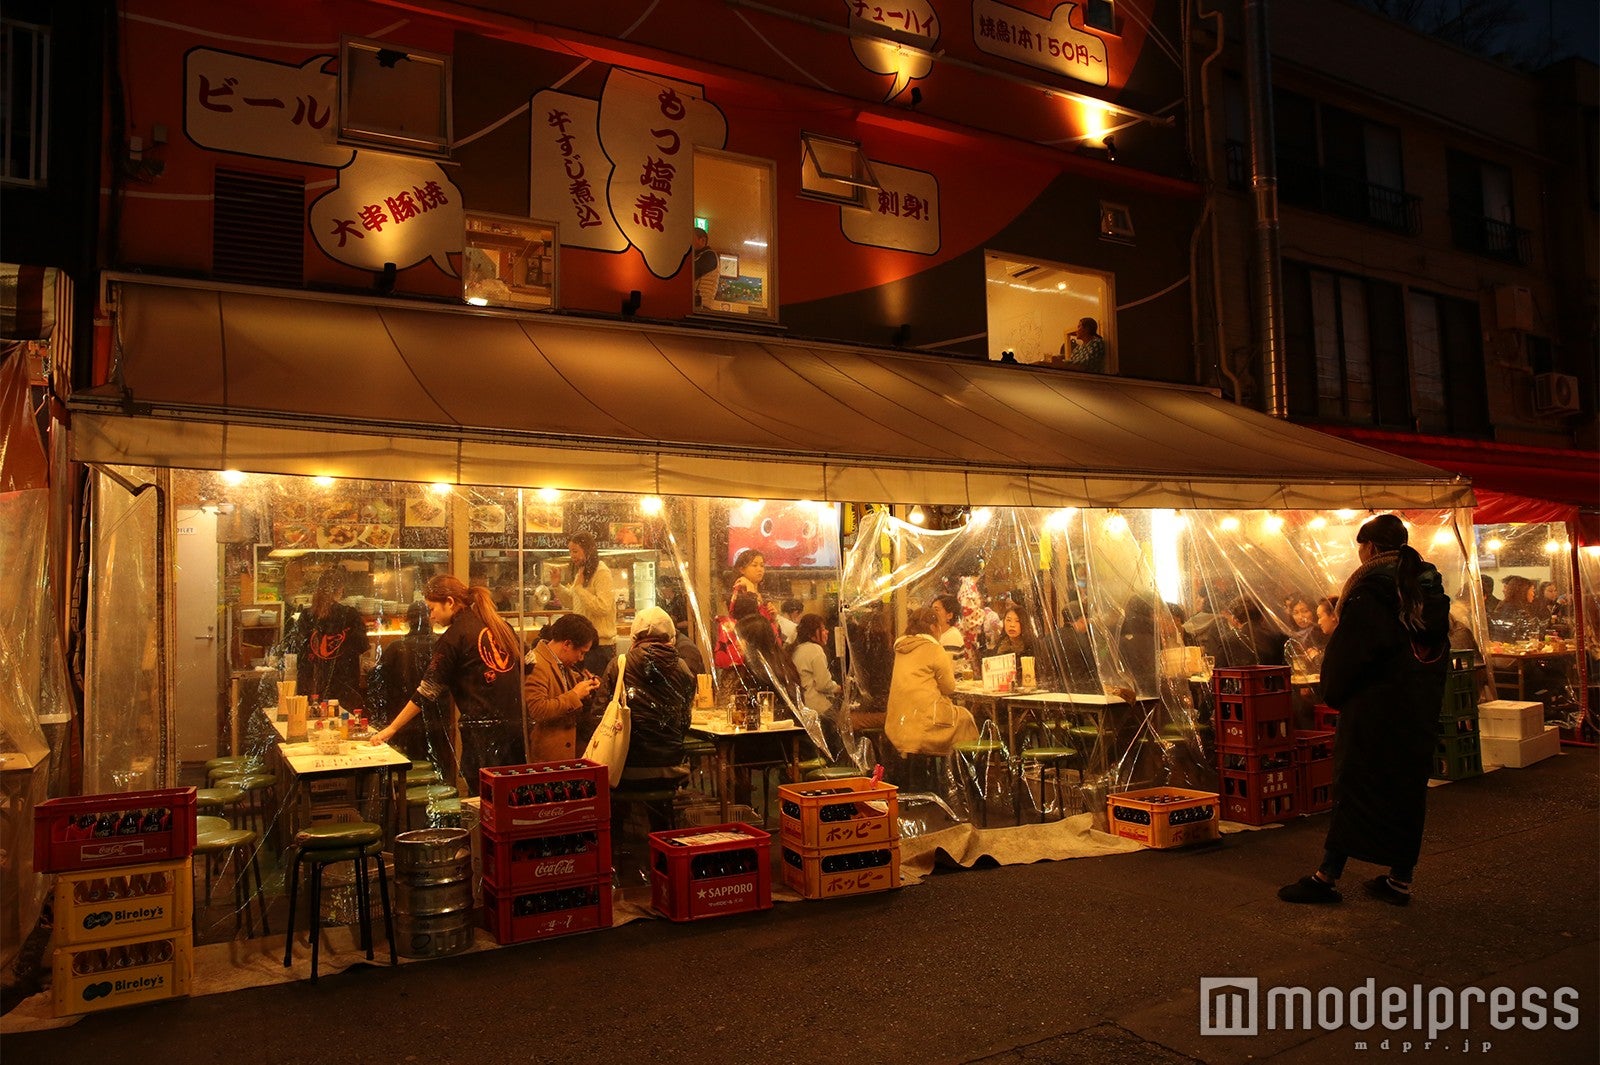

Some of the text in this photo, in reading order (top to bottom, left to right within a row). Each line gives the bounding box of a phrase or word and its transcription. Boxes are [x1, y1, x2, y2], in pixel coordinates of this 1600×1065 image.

[198, 74, 331, 130] ビール
[547, 108, 602, 229] 牛すじ煮込
[634, 87, 686, 233] もつ塩煮
[330, 180, 449, 248] 大串豚焼
[877, 187, 929, 221] 刺身!
[826, 821, 883, 842] ホッピー
[534, 859, 577, 878] Coca-Cola
[708, 882, 753, 898] SAPPORO
[827, 871, 884, 892] ホッピー
[115, 906, 164, 921] Bireley's
[115, 975, 164, 991] Bireley's
